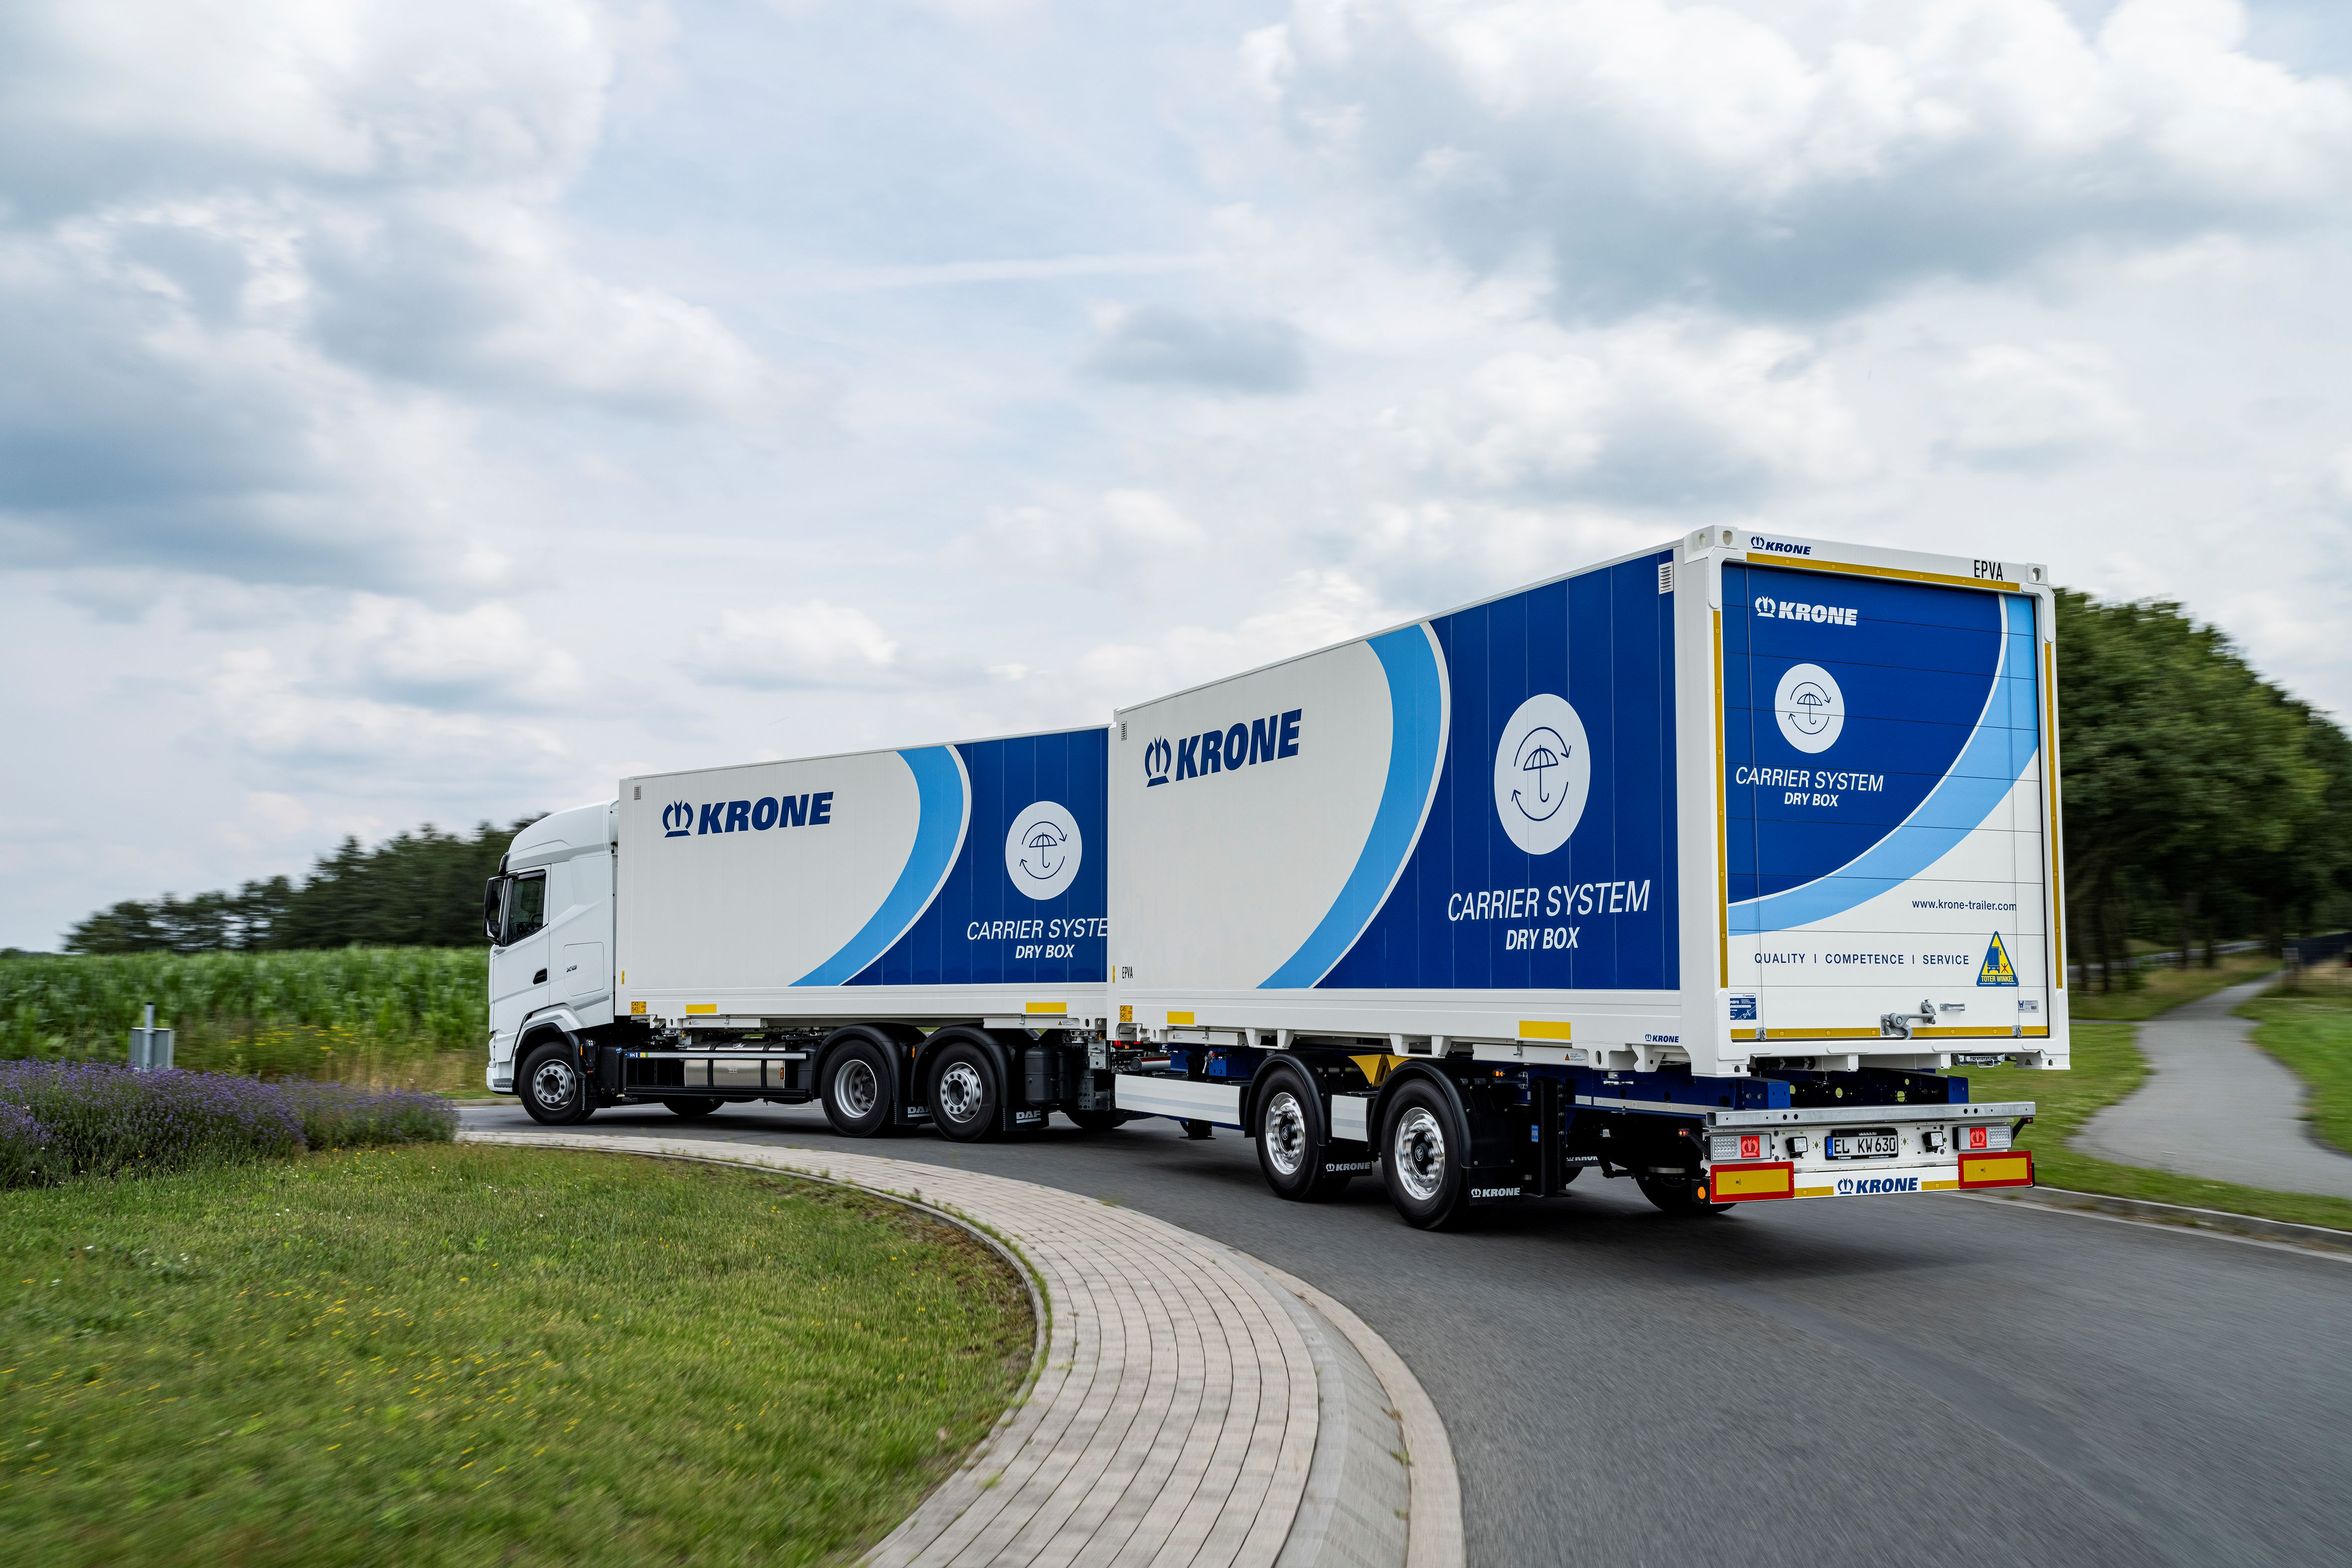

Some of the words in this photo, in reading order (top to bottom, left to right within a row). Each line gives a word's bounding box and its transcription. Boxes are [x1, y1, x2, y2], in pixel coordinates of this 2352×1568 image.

[1765, 541, 1812, 555] KRONE
[1973, 559, 2004, 581] EPVA
[1778, 601, 1858, 626] KRONE
[1175, 708, 1303, 781] KRONE
[1735, 767, 1810, 788] CARRIER
[1814, 771, 1884, 792] SYSTEM
[1784, 792, 1810, 805] DRY
[1812, 793, 1839, 807] BOX
[697, 791, 834, 835] KRONE
[1448, 888, 1540, 921] CARRIER
[1545, 879, 1651, 916] SYSTEM
[1911, 898, 2017, 912] www.krone-trailer.com
[967, 920, 1044, 940] CARRIER
[1048, 918, 1108, 938] SYSTE
[1505, 928, 1541, 950] DRY
[1542, 926, 1581, 949] BOX
[1015, 945, 1043, 959] DRY
[1045, 944, 1075, 958] BOX
[1754, 952, 1806, 965] QUALITY
[1825, 953, 1904, 965] COMPETENCE
[1922, 954, 1969, 965] SERVICE
[1981, 975, 1996, 983] TOTER
[1997, 975, 2014, 983] WINKEL
[1652, 1034, 1680, 1043] KRONE
[1015, 1111, 1041, 1120] DAF
[1834, 1139, 1850, 1154] EL
[1857, 1138, 1873, 1153] KW
[1875, 1137, 1896, 1152] 630
[1335, 1162, 1371, 1172] KRONE
[1482, 1187, 1521, 1198] KRONE
[1856, 1177, 1918, 1193] KRONE
